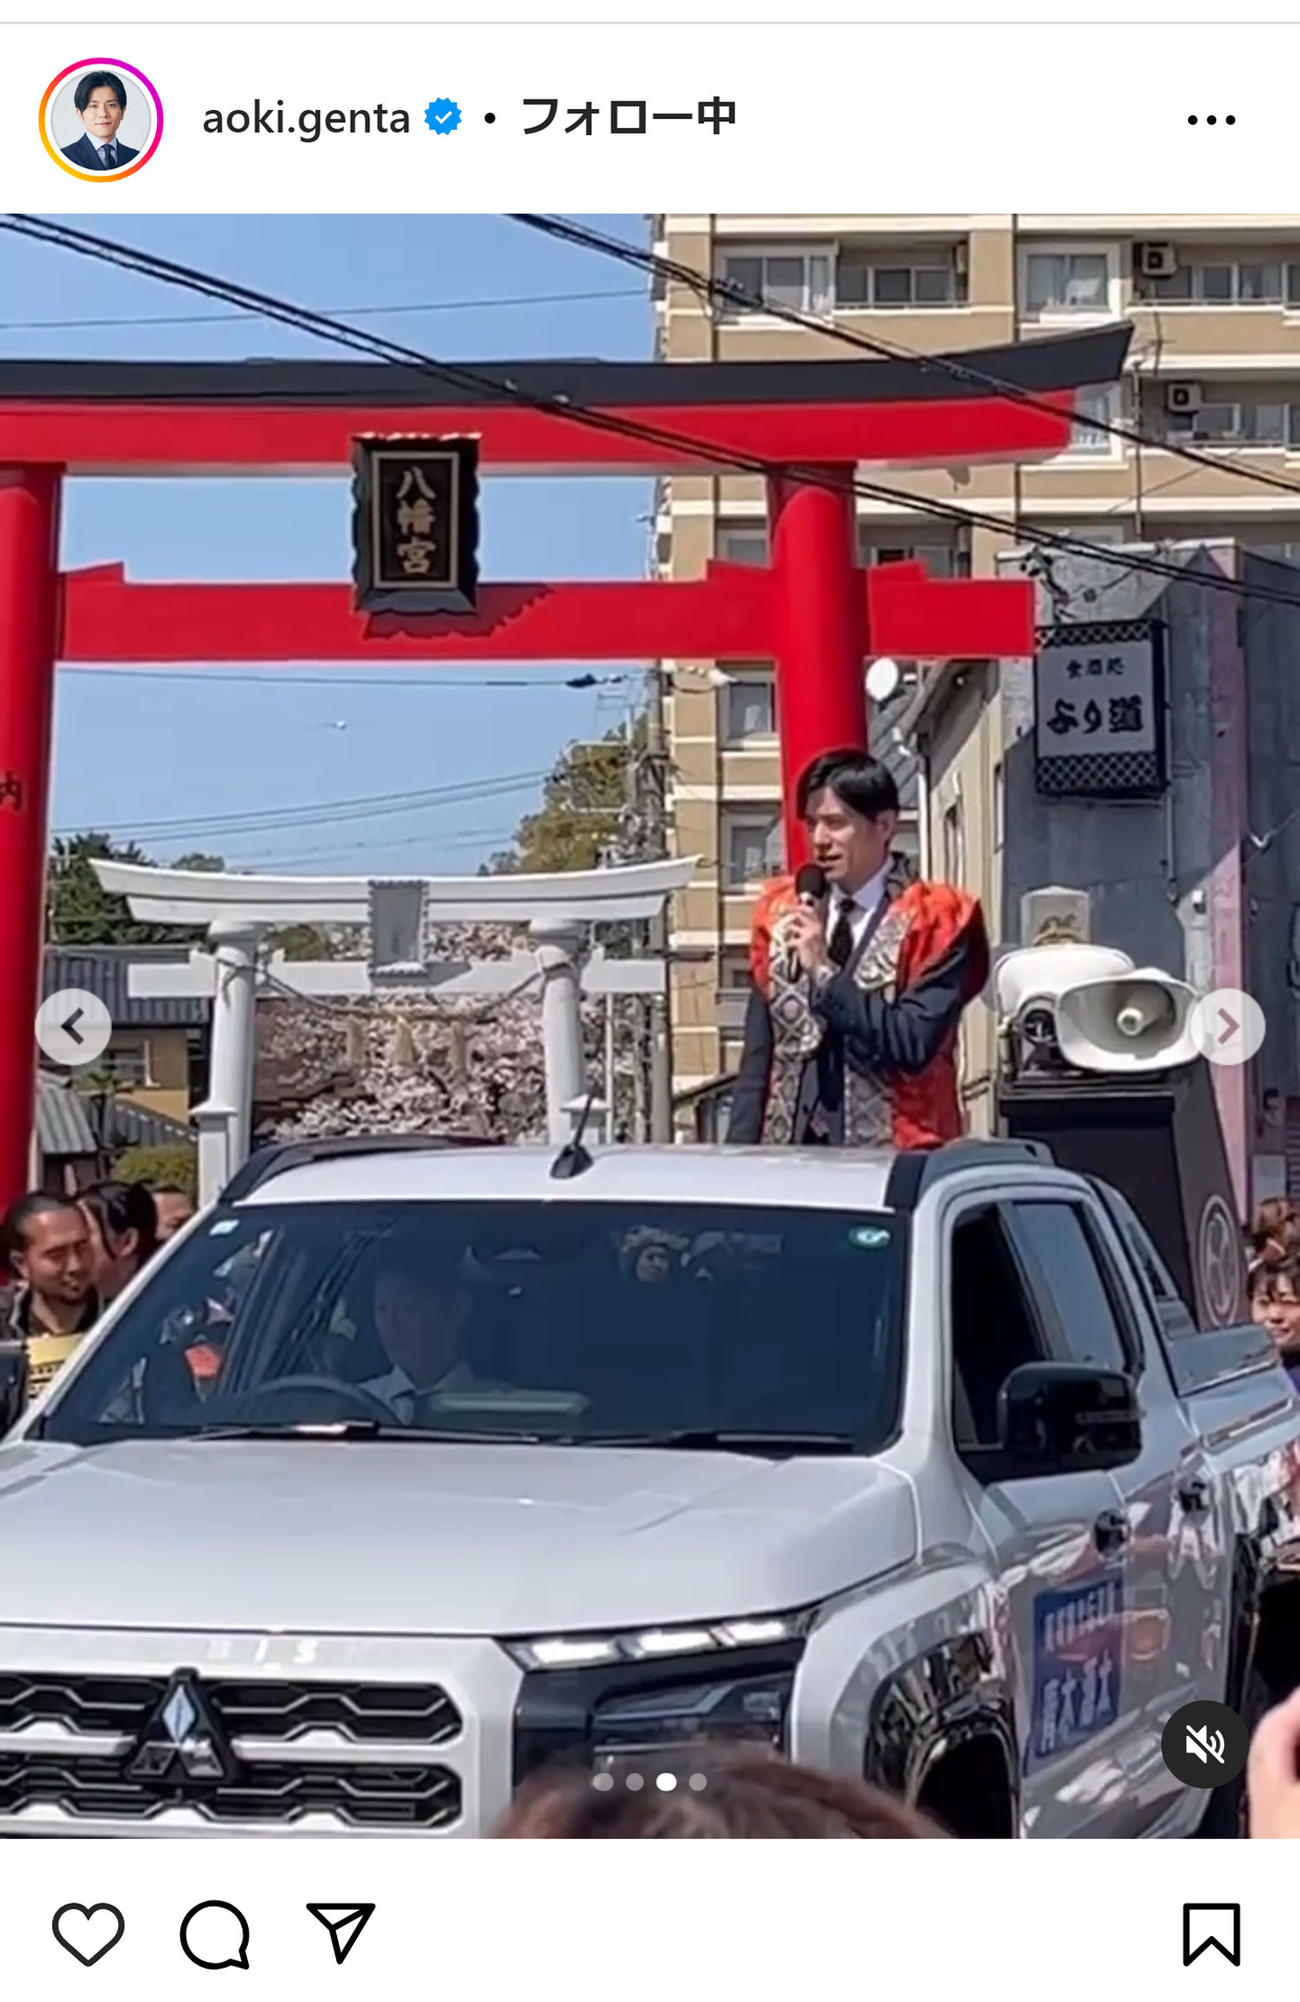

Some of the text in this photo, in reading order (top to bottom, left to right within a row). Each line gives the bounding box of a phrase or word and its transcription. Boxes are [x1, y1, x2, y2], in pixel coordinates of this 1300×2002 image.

[396, 466, 436, 574] 八幡宮
[1047, 694, 1143, 735] より道
